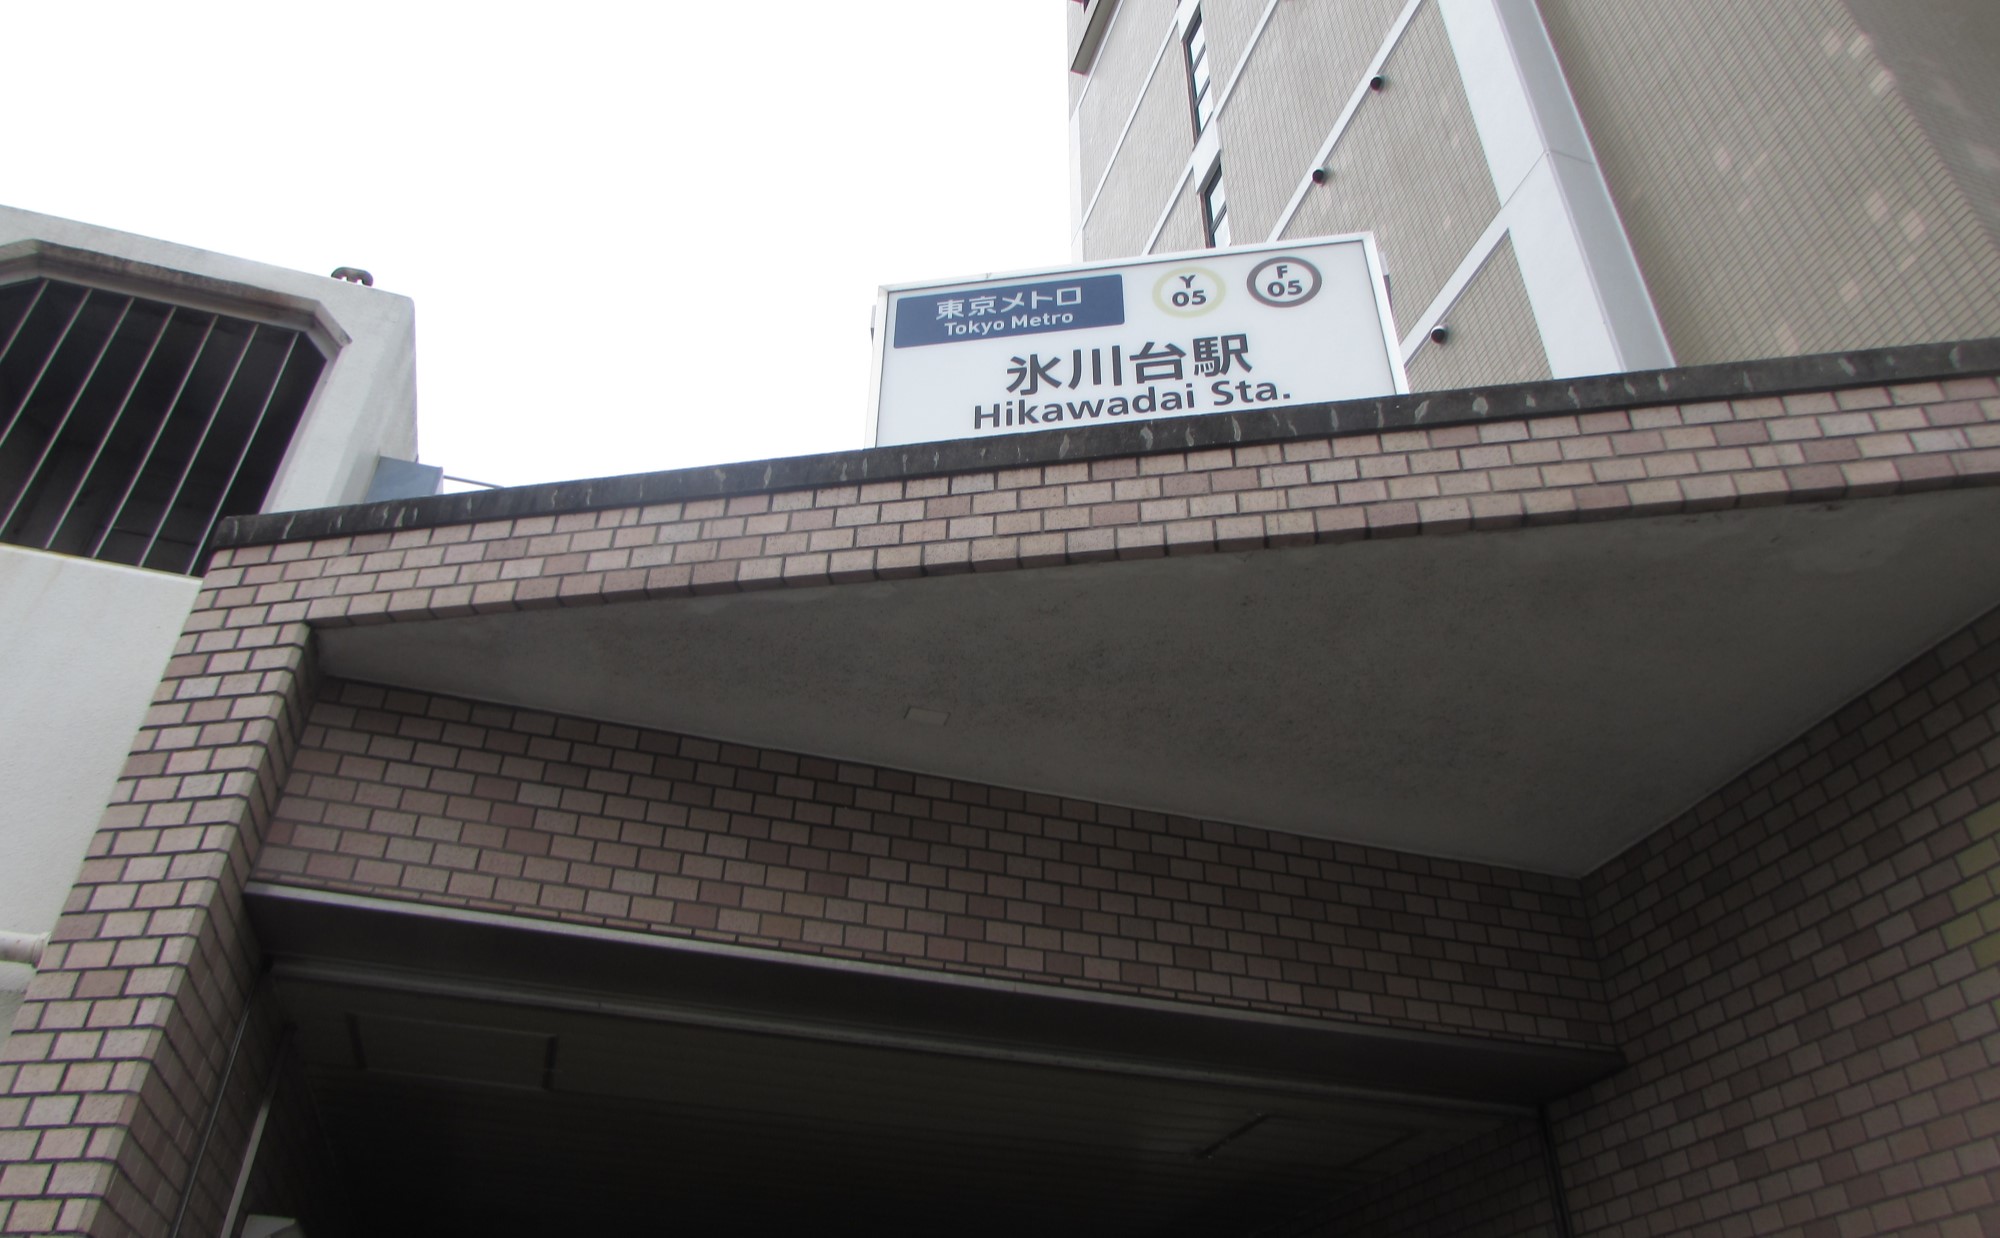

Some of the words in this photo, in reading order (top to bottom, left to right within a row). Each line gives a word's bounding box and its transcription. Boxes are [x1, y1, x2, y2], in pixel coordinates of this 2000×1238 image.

[1178, 275, 1197, 289] Y
[1276, 265, 1288, 279] F
[1171, 290, 1207, 307] 05
[1267, 280, 1303, 298] 05
[936, 286, 1083, 321] 東京メトロ
[944, 319, 1005, 337] Tokyo
[1011, 310, 1074, 329] Metro
[1006, 333, 1252, 396] 氷川台駅
[973, 383, 1194, 430] Hikawadai
[1211, 379, 1291, 406] Sta.
